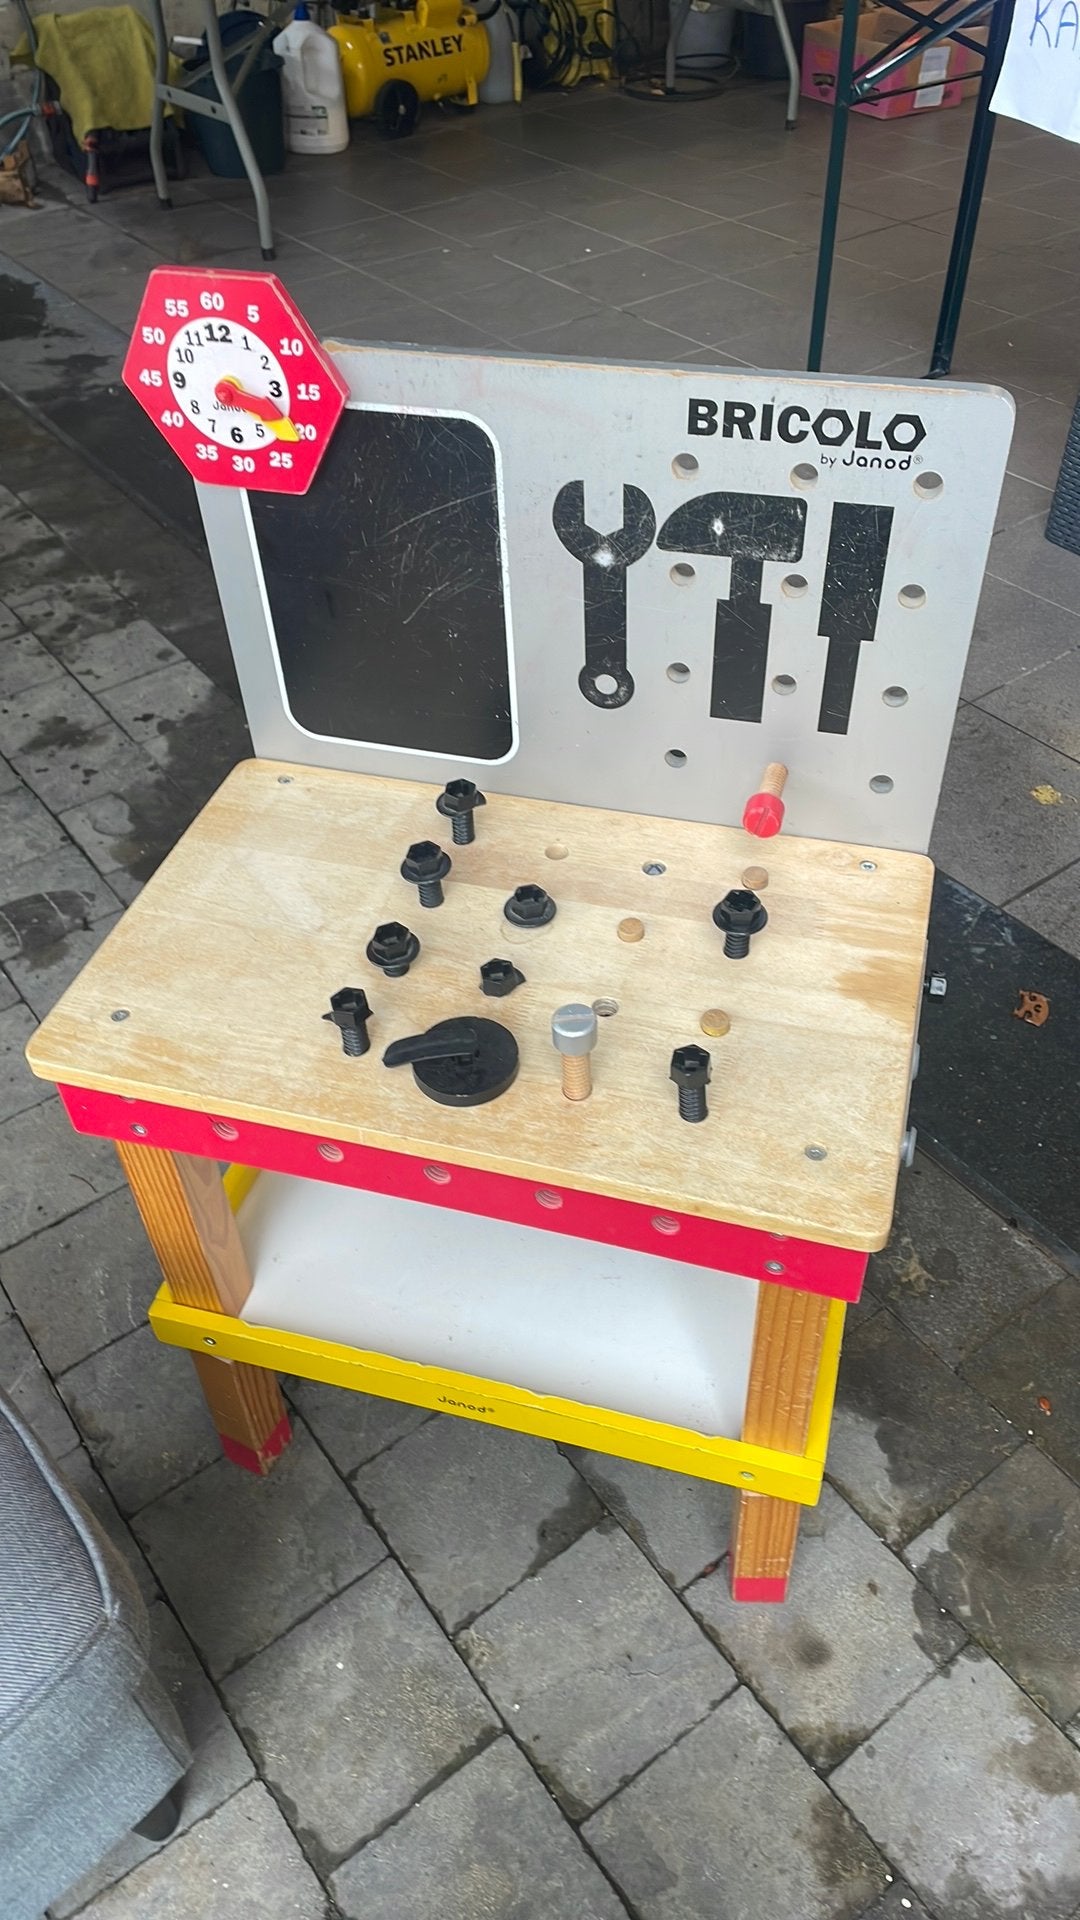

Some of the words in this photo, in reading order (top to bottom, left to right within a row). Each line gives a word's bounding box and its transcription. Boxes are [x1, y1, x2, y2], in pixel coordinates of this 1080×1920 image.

[383, 34, 464, 67] STANLEY
[165, 299, 189, 317] 55
[200, 292, 224, 310] 60
[247, 305, 260, 322] 5
[142, 327, 165, 345] 50
[185, 330, 204, 347] 11
[205, 325, 232, 342] 12
[242, 336, 251, 350] 1
[280, 338, 303, 356] 10
[176, 348, 194, 364] 10
[261, 356, 271, 370] 2
[139, 370, 162, 386] 45
[174, 372, 186, 389] 9
[269, 381, 282, 398] 3
[297, 384, 320, 401] 15
[191, 400, 200, 414] 8
[161, 410, 183, 428] 40
[208, 419, 217, 433] 7
[688, 398, 927, 452] BRICOLO
[231, 428, 244, 443] 6
[256, 424, 264, 437] 5
[196, 444, 218, 460] 35
[269, 452, 293, 468] 25
[820, 453, 837, 467] by
[232, 455, 255, 472] 30
